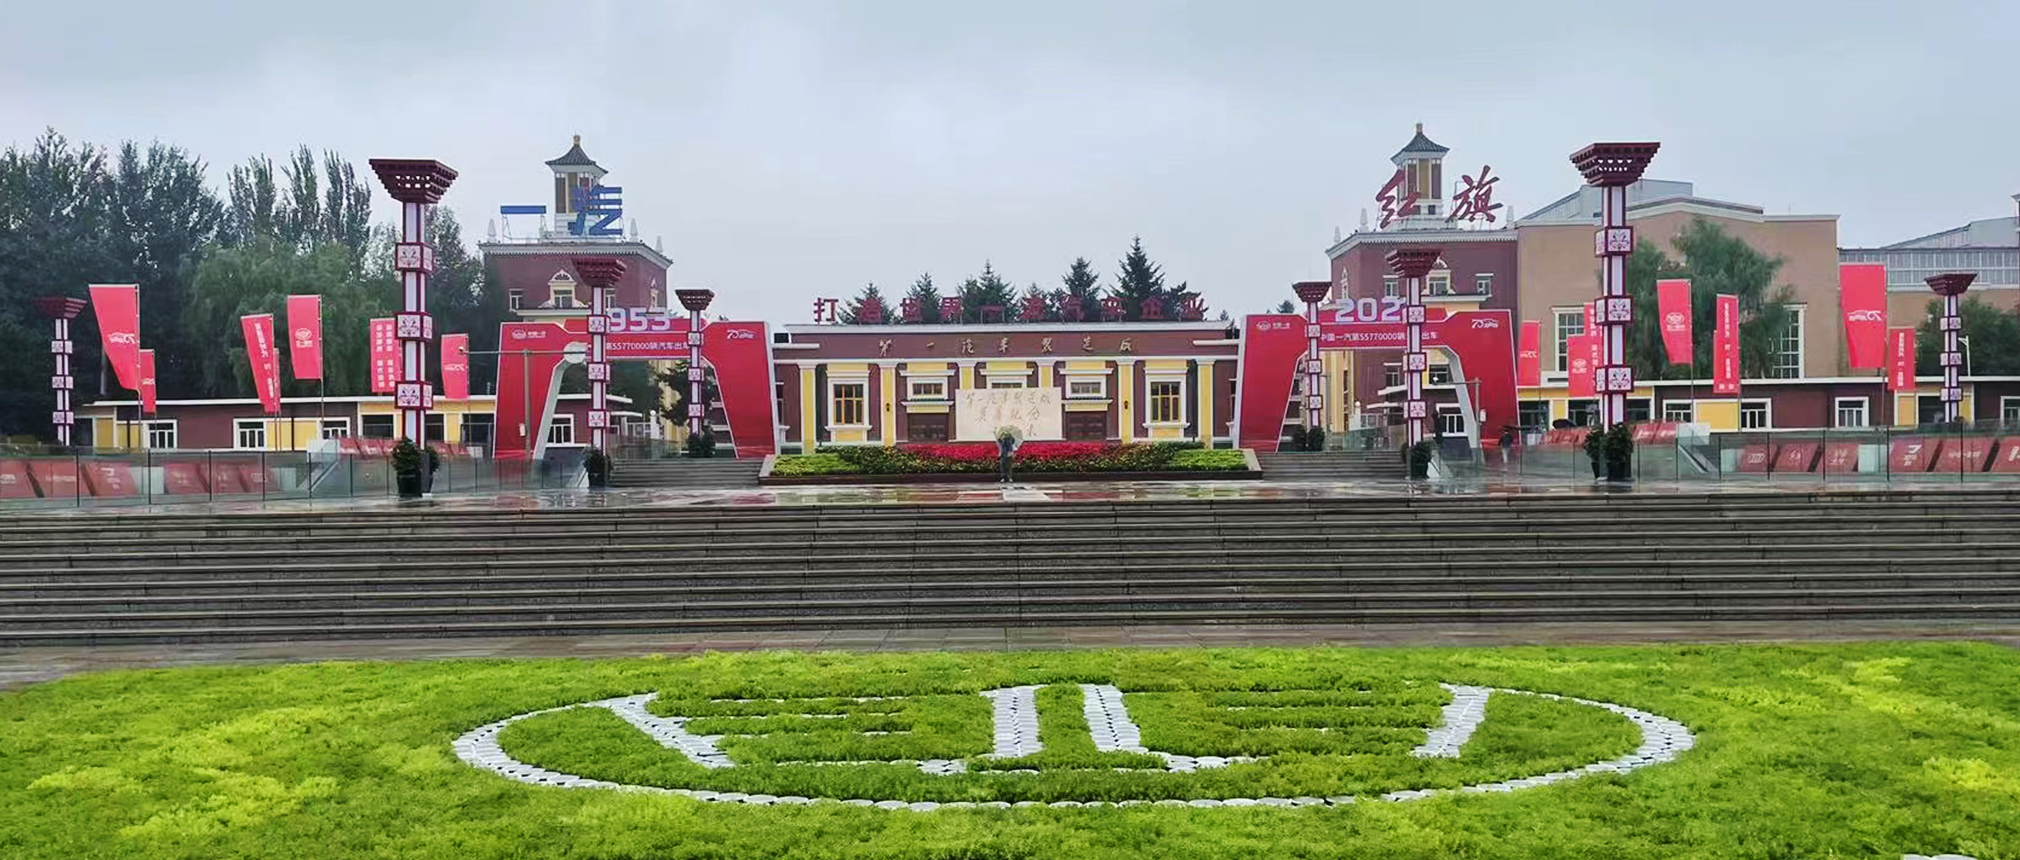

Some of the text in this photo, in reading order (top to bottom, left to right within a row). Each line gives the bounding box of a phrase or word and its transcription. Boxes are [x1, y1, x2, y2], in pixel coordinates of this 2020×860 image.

[500, 186, 622, 236] 一汽
[1376, 165, 1503, 229] 红旗
[608, 308, 670, 331] 953
[1335, 298, 1406, 322] 202
